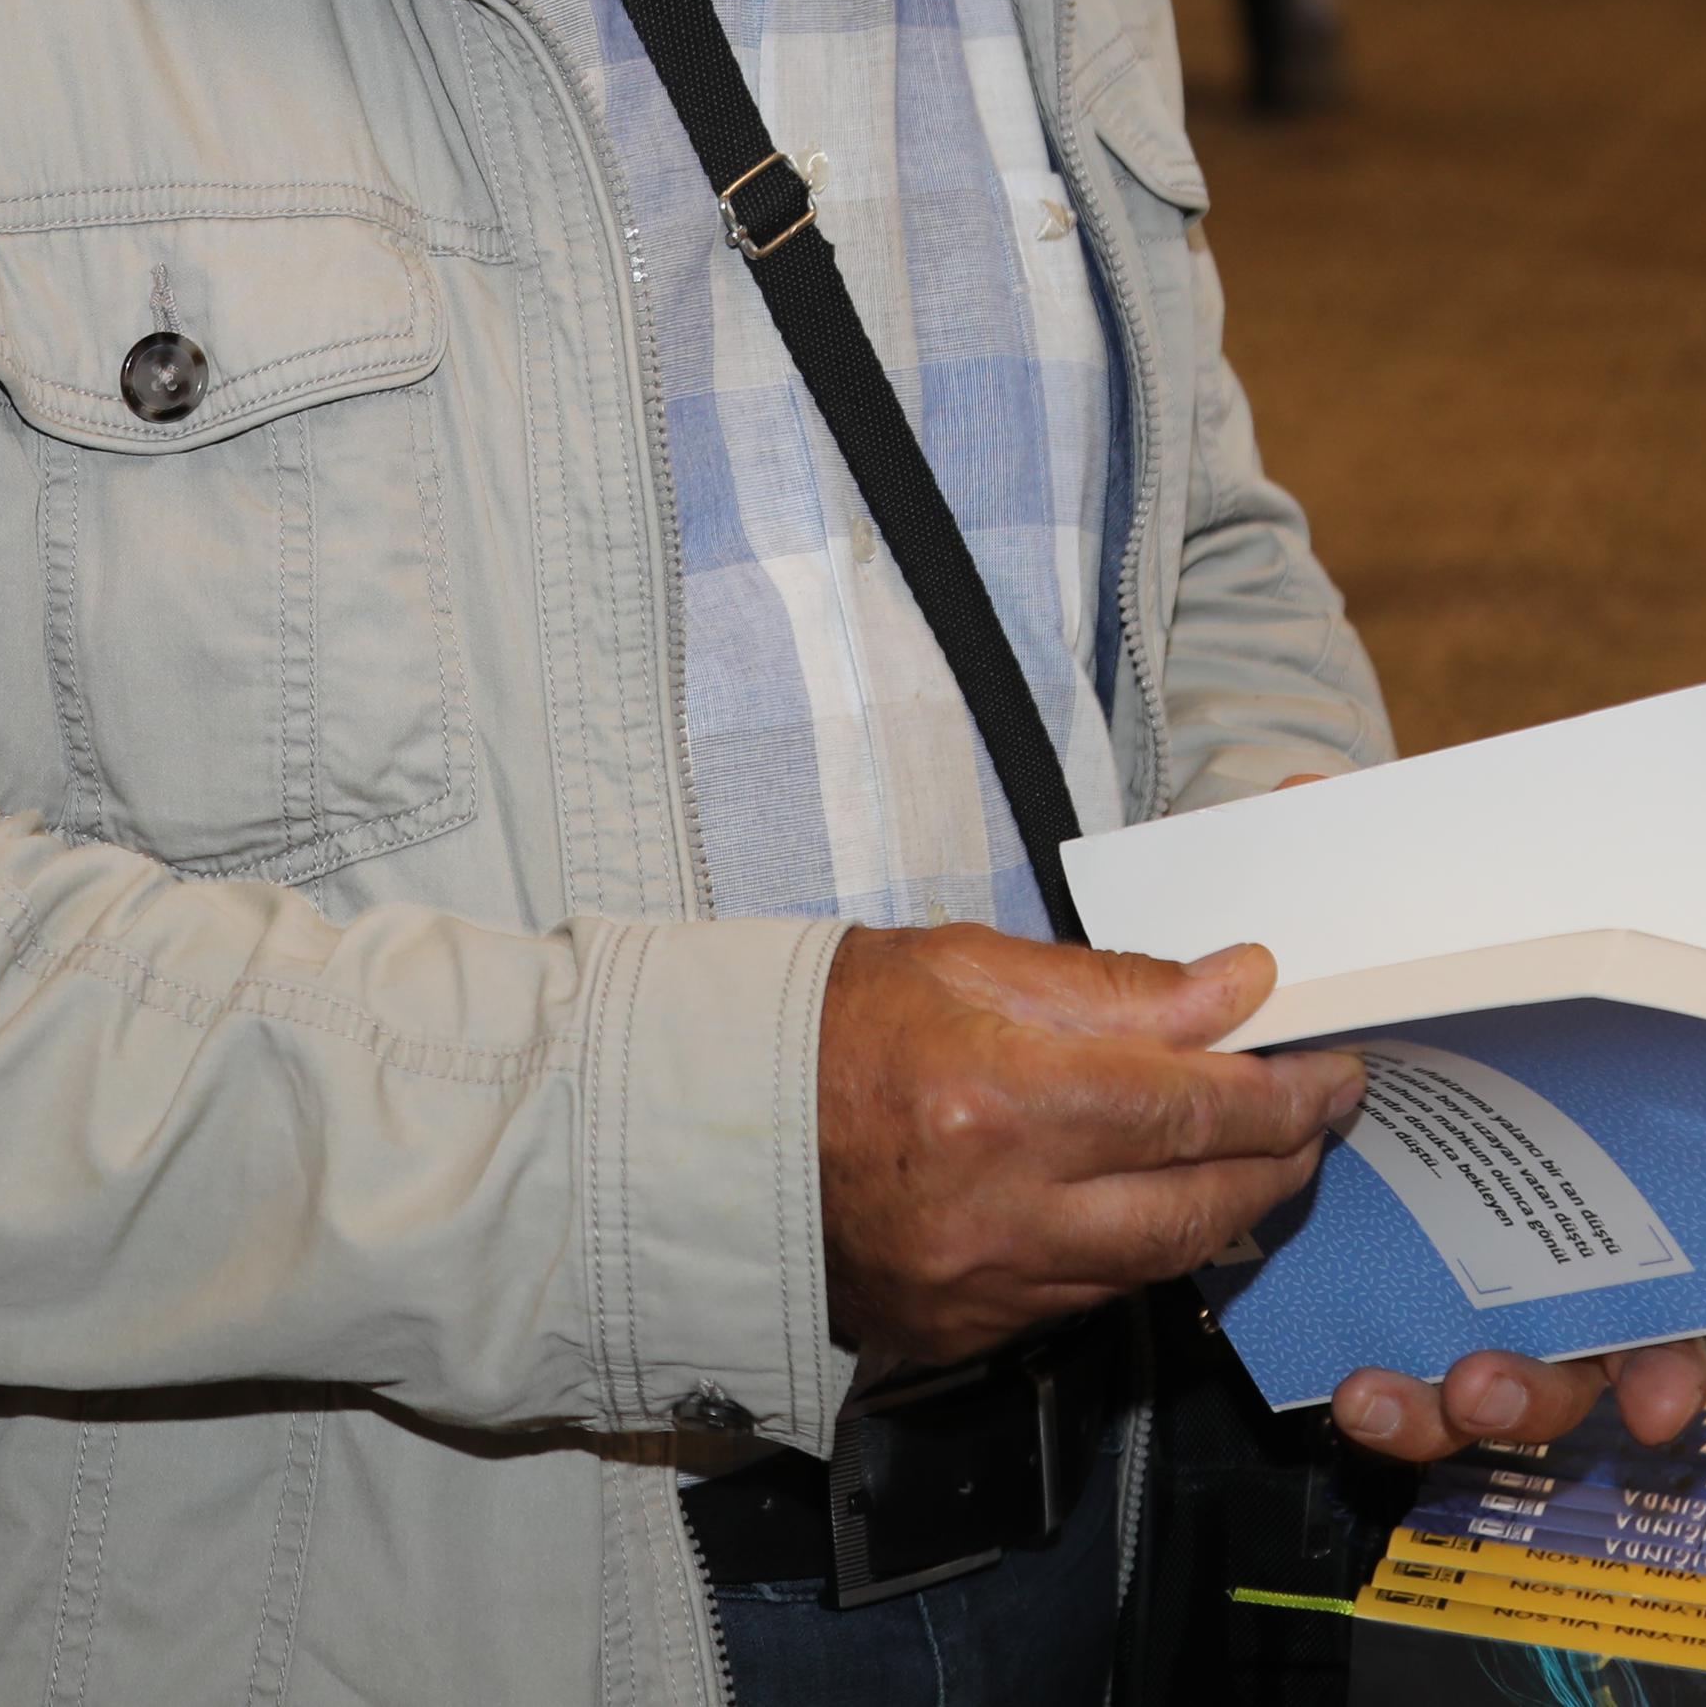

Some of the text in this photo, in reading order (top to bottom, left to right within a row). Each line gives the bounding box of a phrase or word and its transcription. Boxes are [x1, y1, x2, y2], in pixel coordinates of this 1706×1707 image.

[1357, 1100, 1398, 1130] ultan
[1380, 1080, 1434, 1113] ruhuna
[1433, 1114, 1494, 1167] mahkum
[1491, 1169, 1534, 1217] olunca
[1527, 1219, 1572, 1265] gönül
[1404, 1114, 1459, 1163] dorukta
[1457, 1161, 1514, 1227] bekleyen
[1434, 1094, 1474, 1121] boyu
[1471, 1121, 1522, 1167] uzayan
[1519, 1168, 1559, 1210] vatan
[1554, 1212, 1596, 1258] düştü
[1489, 1115, 1544, 1158] yalancı
[1540, 1159, 1564, 1179] bir
[1559, 1180, 1585, 1207] tan
[1581, 1209, 1622, 1255] düştü
[1508, 1579, 1614, 1605] WILSON
[1525, 1548, 1630, 1573] WILSON
[1493, 1606, 1600, 1632] WILSON
